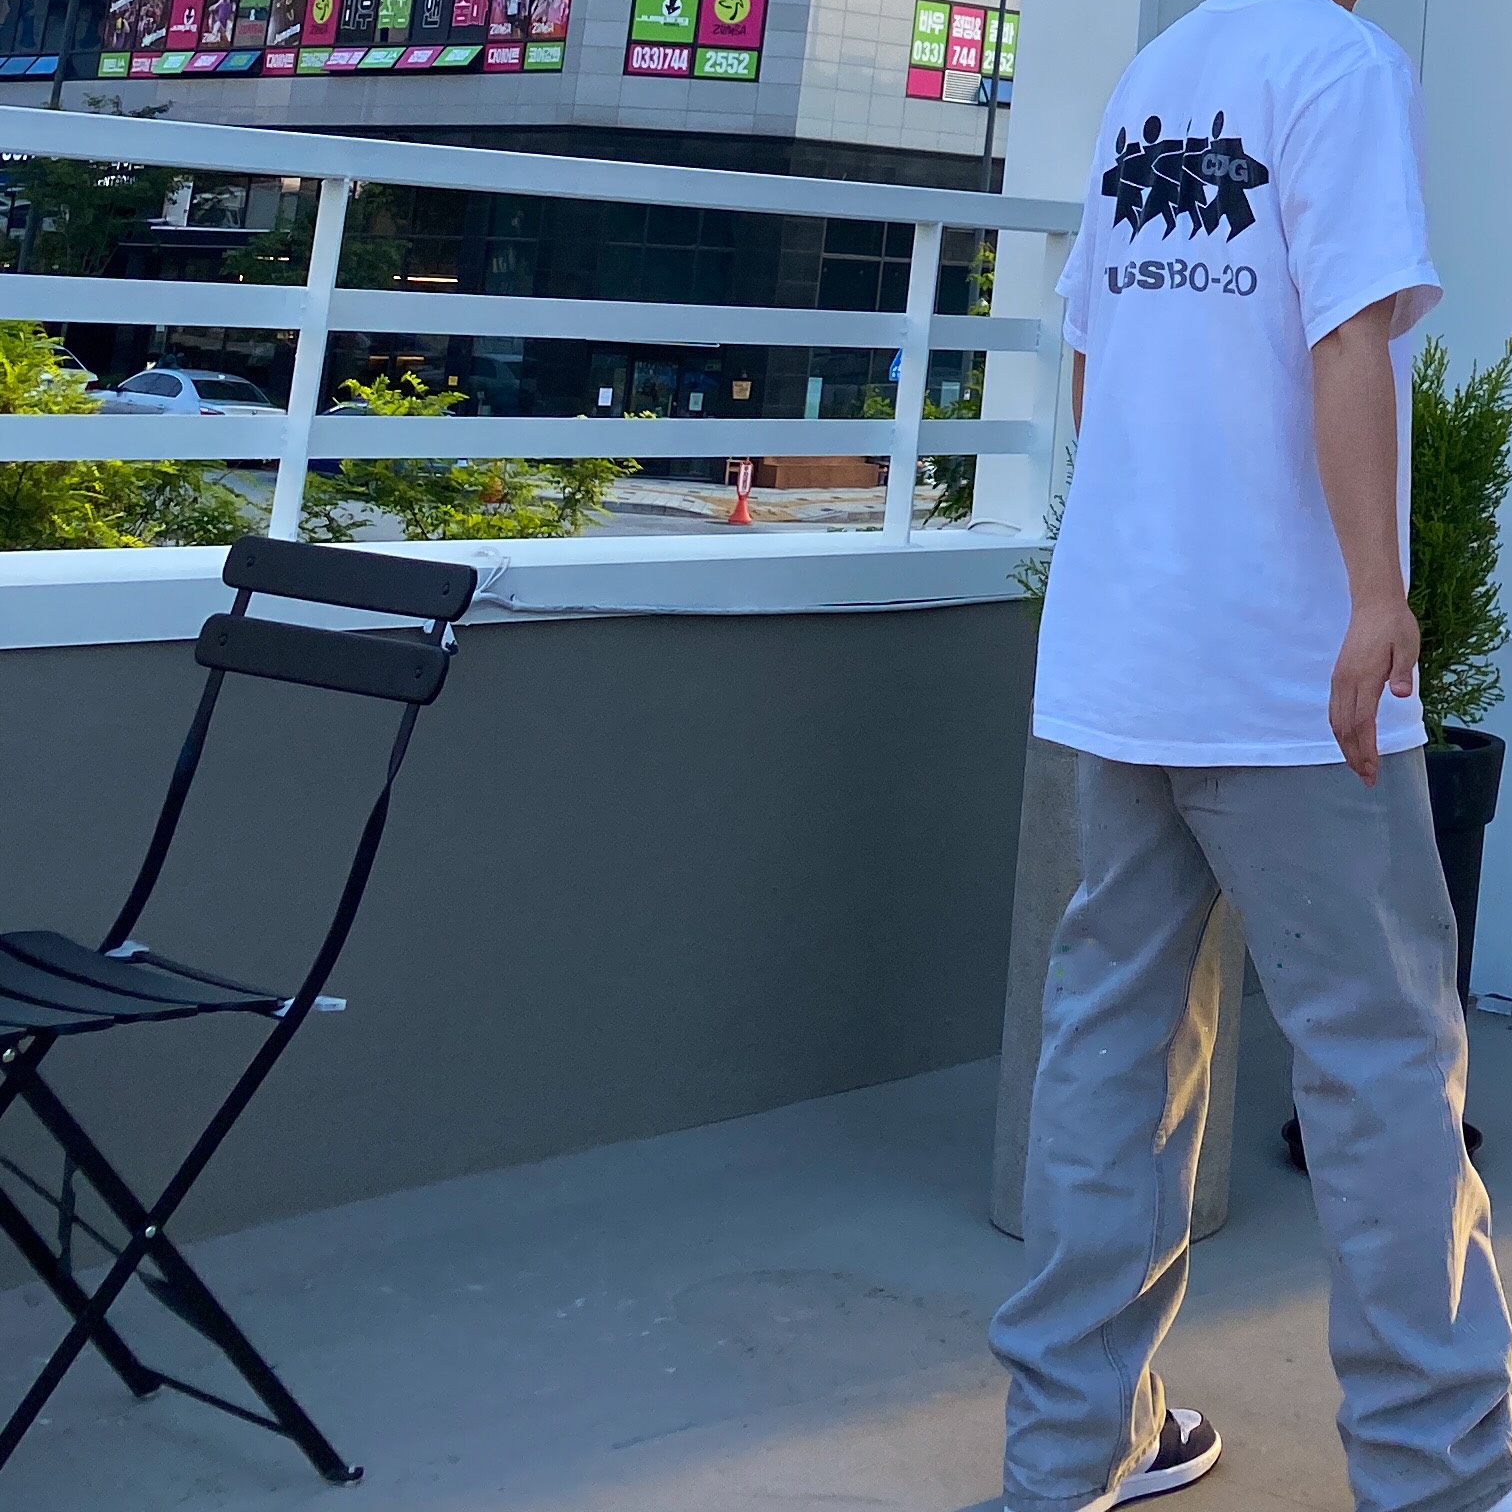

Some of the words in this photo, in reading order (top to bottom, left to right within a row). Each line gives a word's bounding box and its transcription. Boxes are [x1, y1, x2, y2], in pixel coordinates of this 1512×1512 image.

[918, 9, 945, 35] 바우
[632, 46, 689, 71] 033)744
[703, 51, 750, 75] 2552
[952, 46, 976, 68] 744
